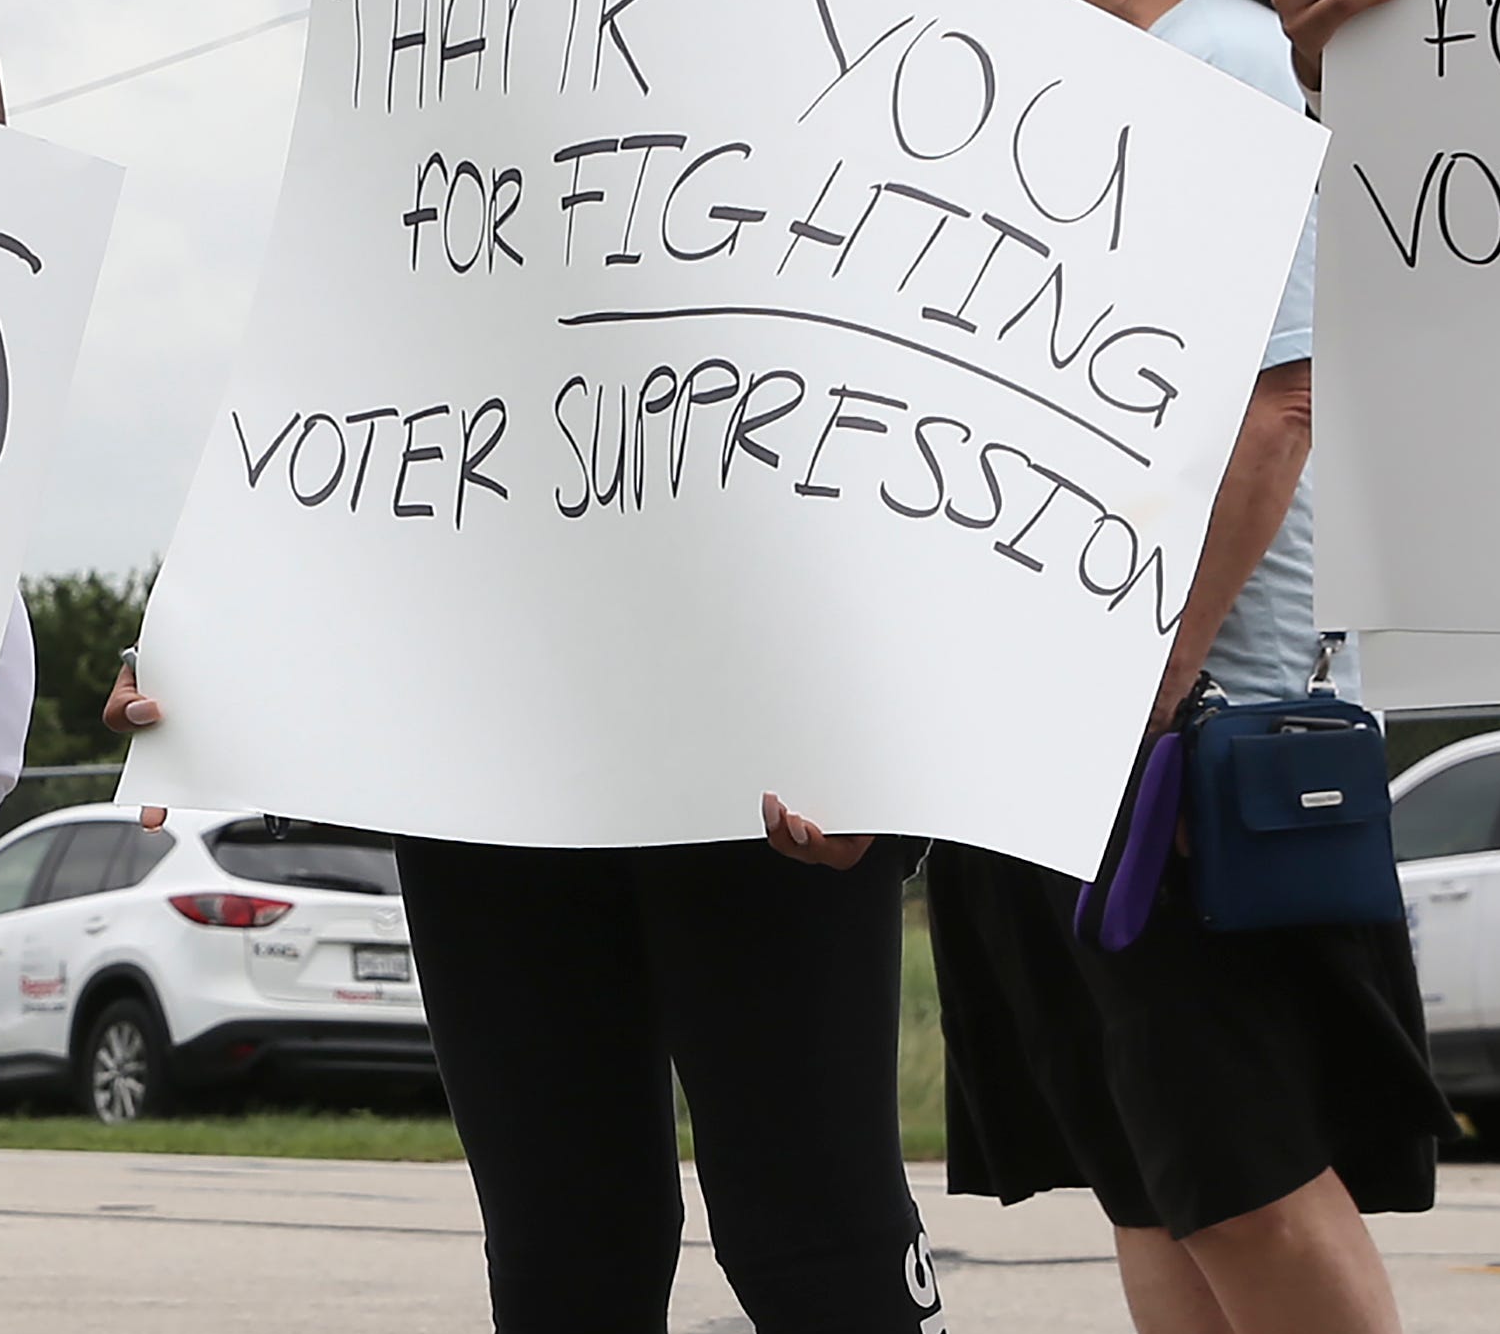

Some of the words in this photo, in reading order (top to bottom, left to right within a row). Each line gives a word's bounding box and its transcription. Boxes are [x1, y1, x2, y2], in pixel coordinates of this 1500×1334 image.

[553, 134, 1186, 429] FIGHTING
[232, 397, 509, 530] VOTER
[554, 357, 1186, 635] SUPPRESSION
